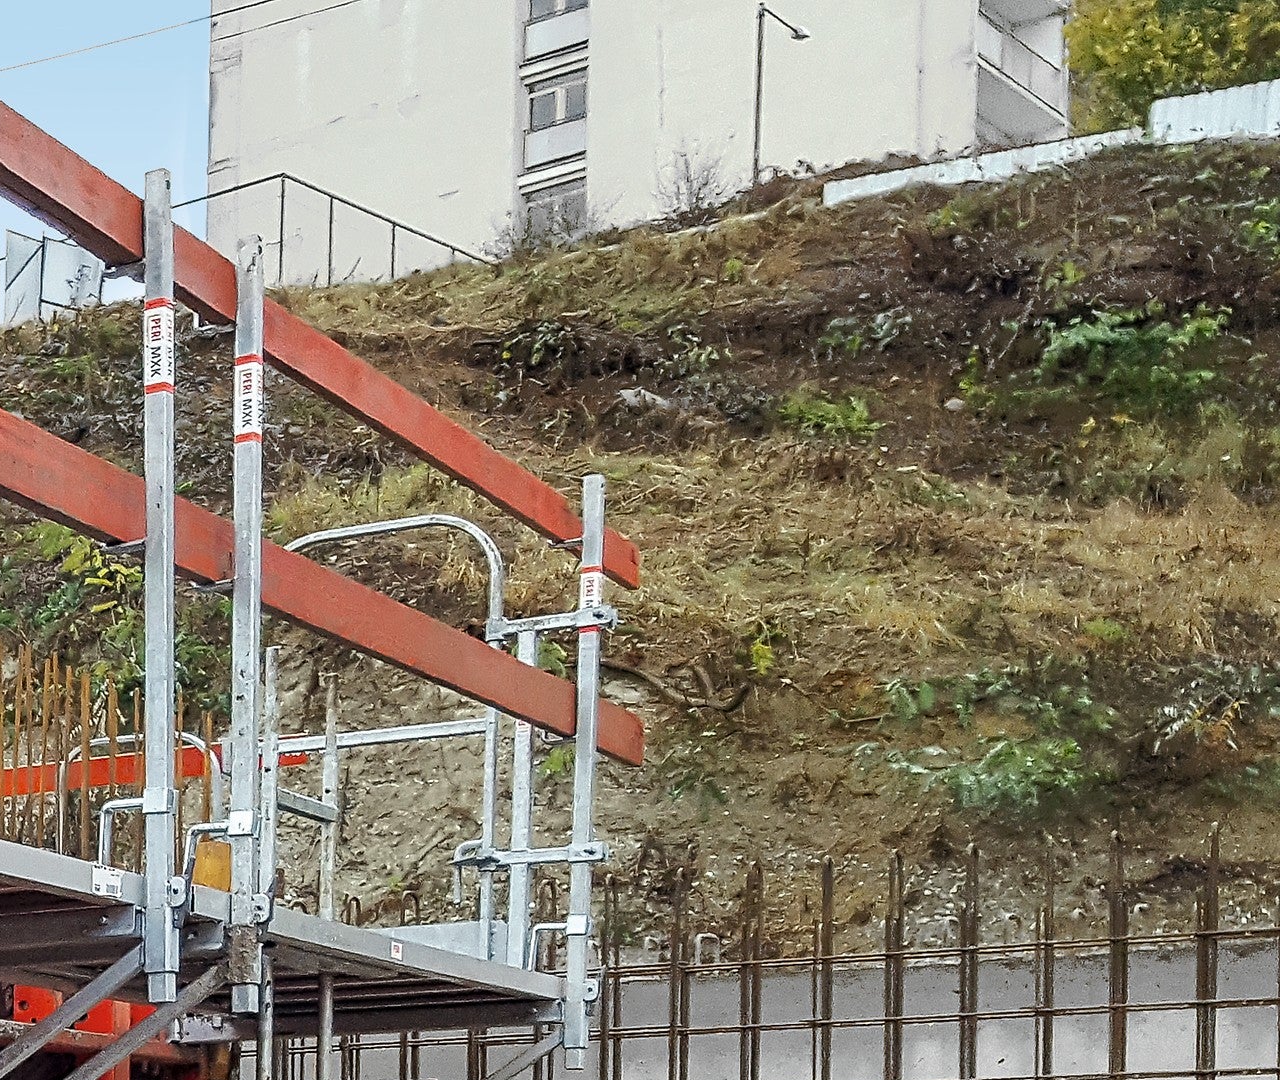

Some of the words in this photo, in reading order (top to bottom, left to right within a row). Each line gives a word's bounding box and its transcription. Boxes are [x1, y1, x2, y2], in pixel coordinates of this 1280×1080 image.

[150, 316, 161, 342] PERI
[150, 346, 161, 378] MXK
[241, 372, 253, 395] PERI
[241, 399, 253, 428] MXK
